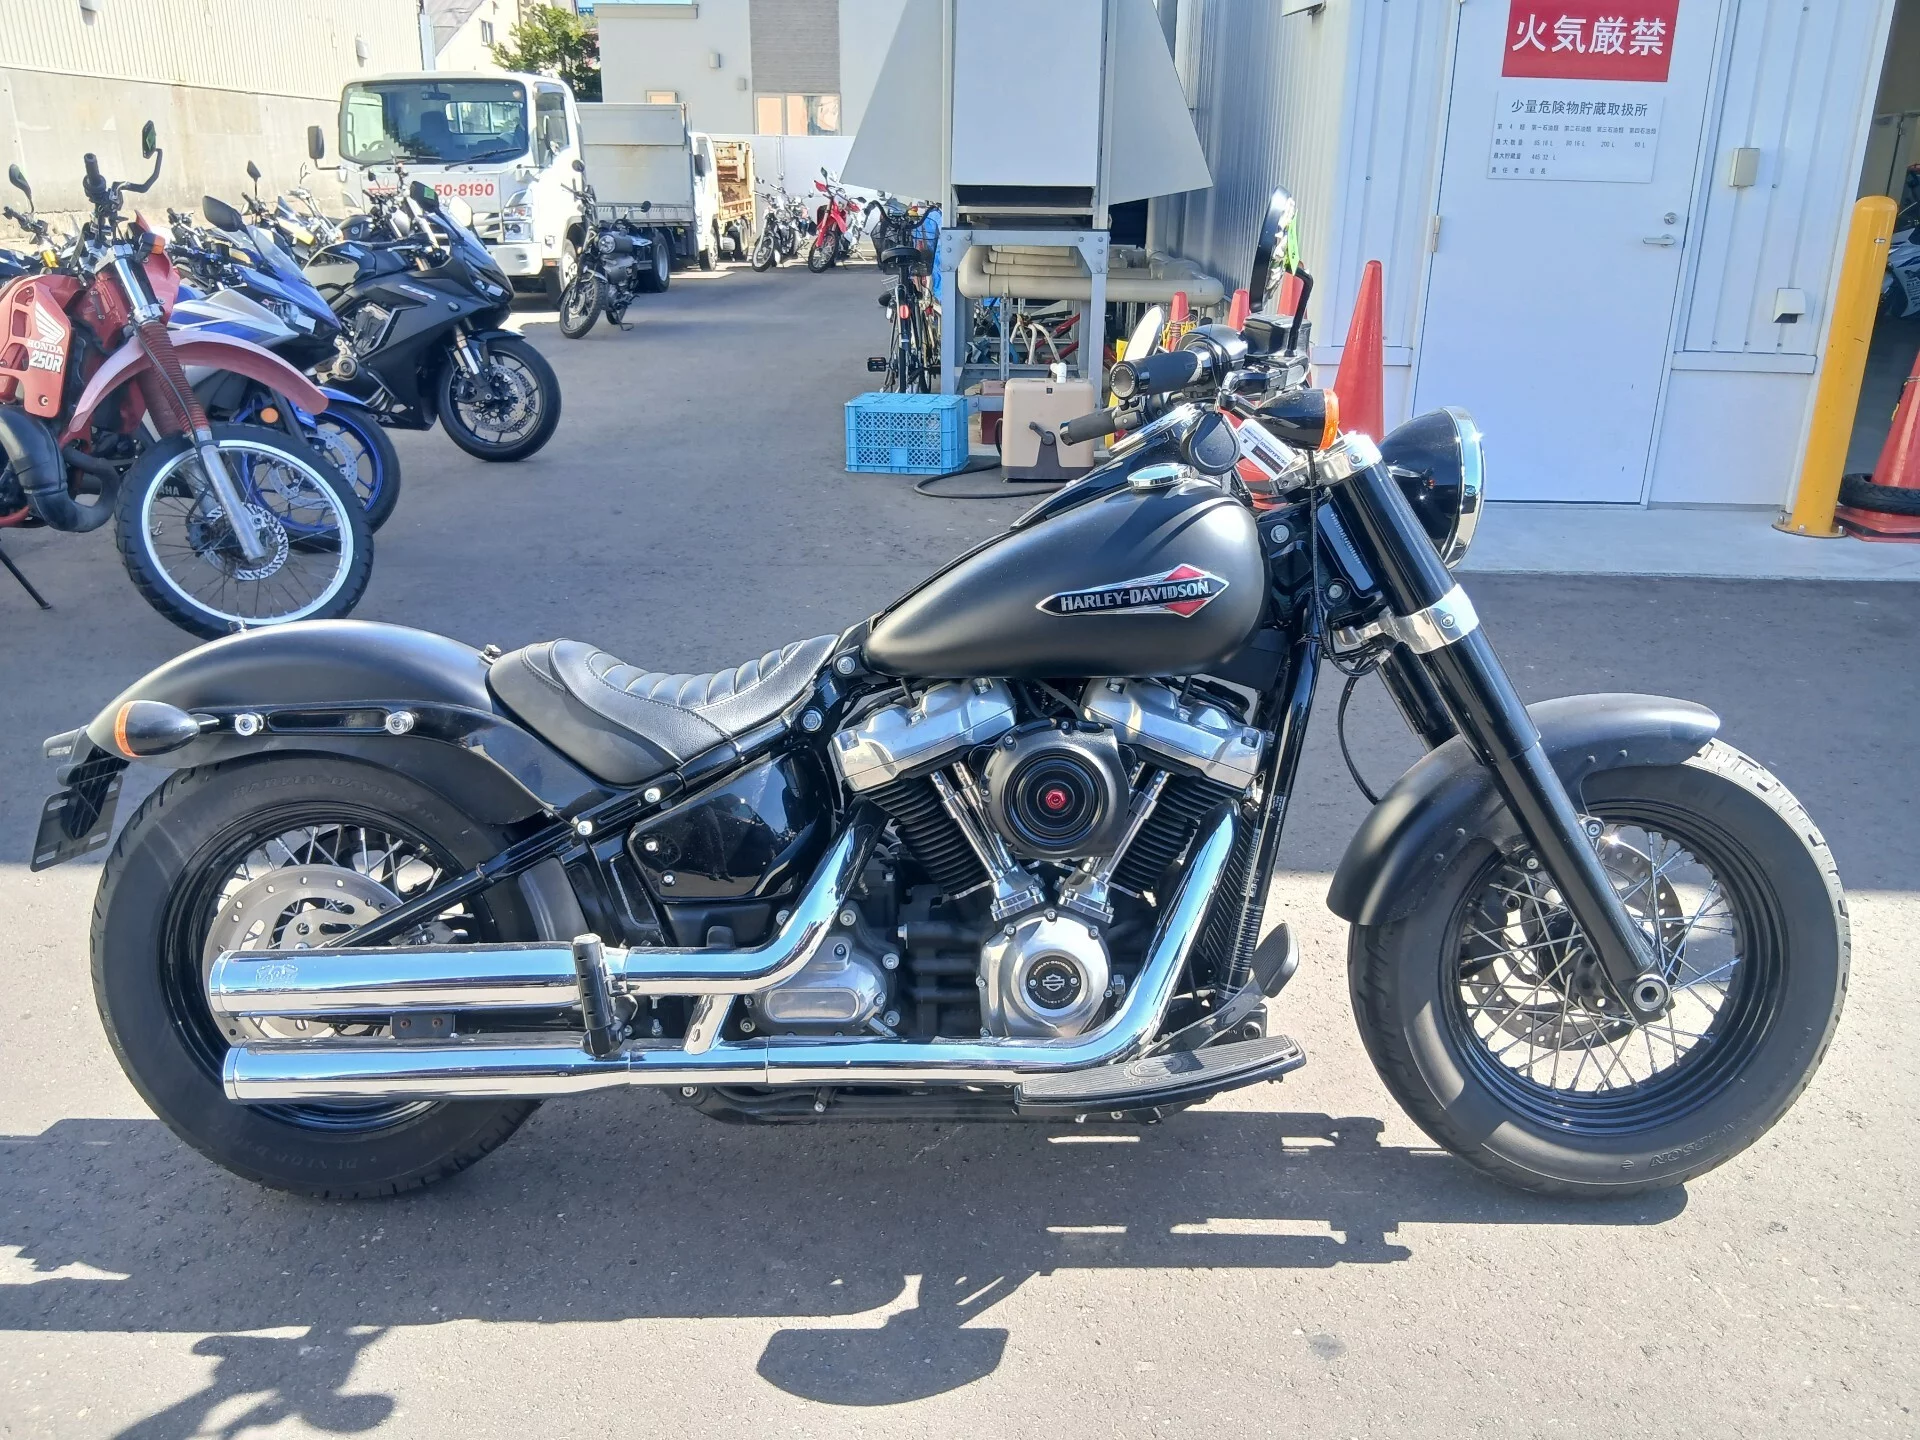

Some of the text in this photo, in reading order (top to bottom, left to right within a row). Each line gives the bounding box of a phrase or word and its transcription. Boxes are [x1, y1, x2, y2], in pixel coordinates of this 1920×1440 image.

[1511, 13, 1667, 56] 火気厳禁
[1511, 99, 1648, 117] 少量危険物貯蔵取扱所
[26, 339, 65, 356] HONDA
[29, 350, 64, 373] 250R
[1060, 580, 1210, 612] HARLEY-DAVIDSON
